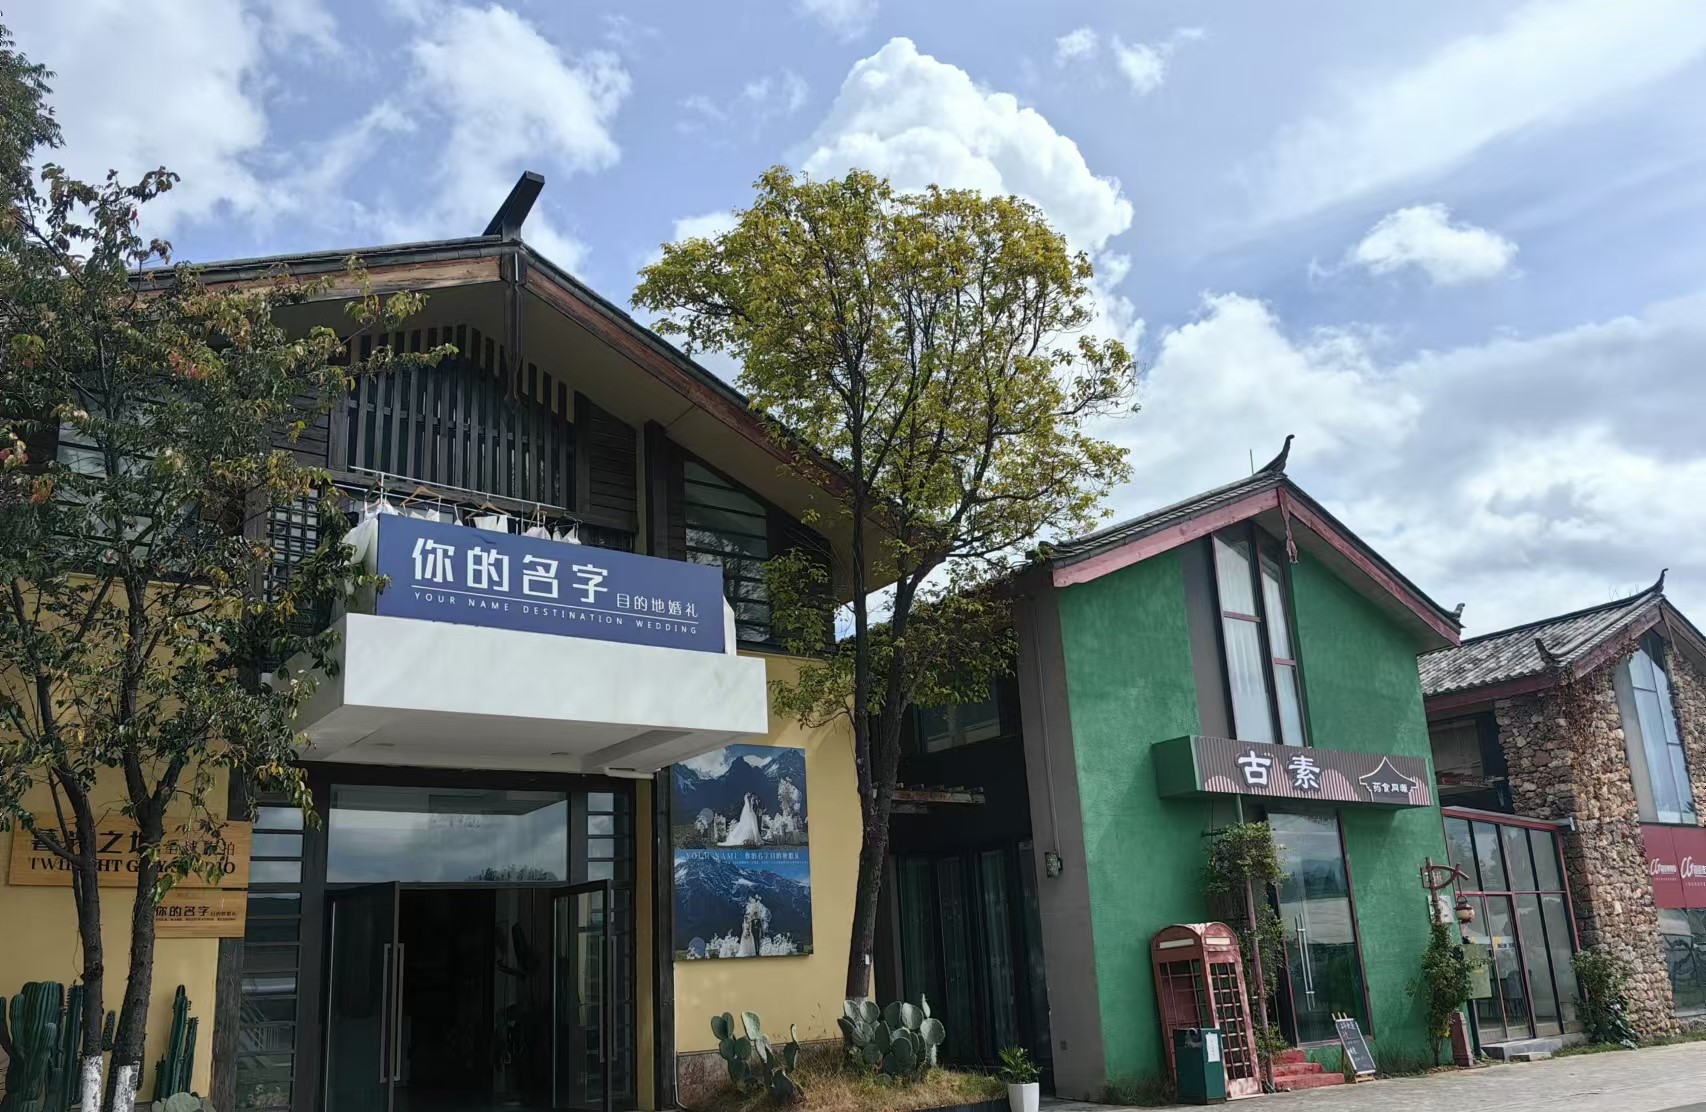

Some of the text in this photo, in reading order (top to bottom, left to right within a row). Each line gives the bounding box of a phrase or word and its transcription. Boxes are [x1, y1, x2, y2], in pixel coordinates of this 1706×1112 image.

[411, 537, 699, 618] 你的名字 目的地婚礼
[414, 591, 698, 635] YOUR NAME DESTINATION WEDDING
[1237, 750, 1320, 789] 古素
